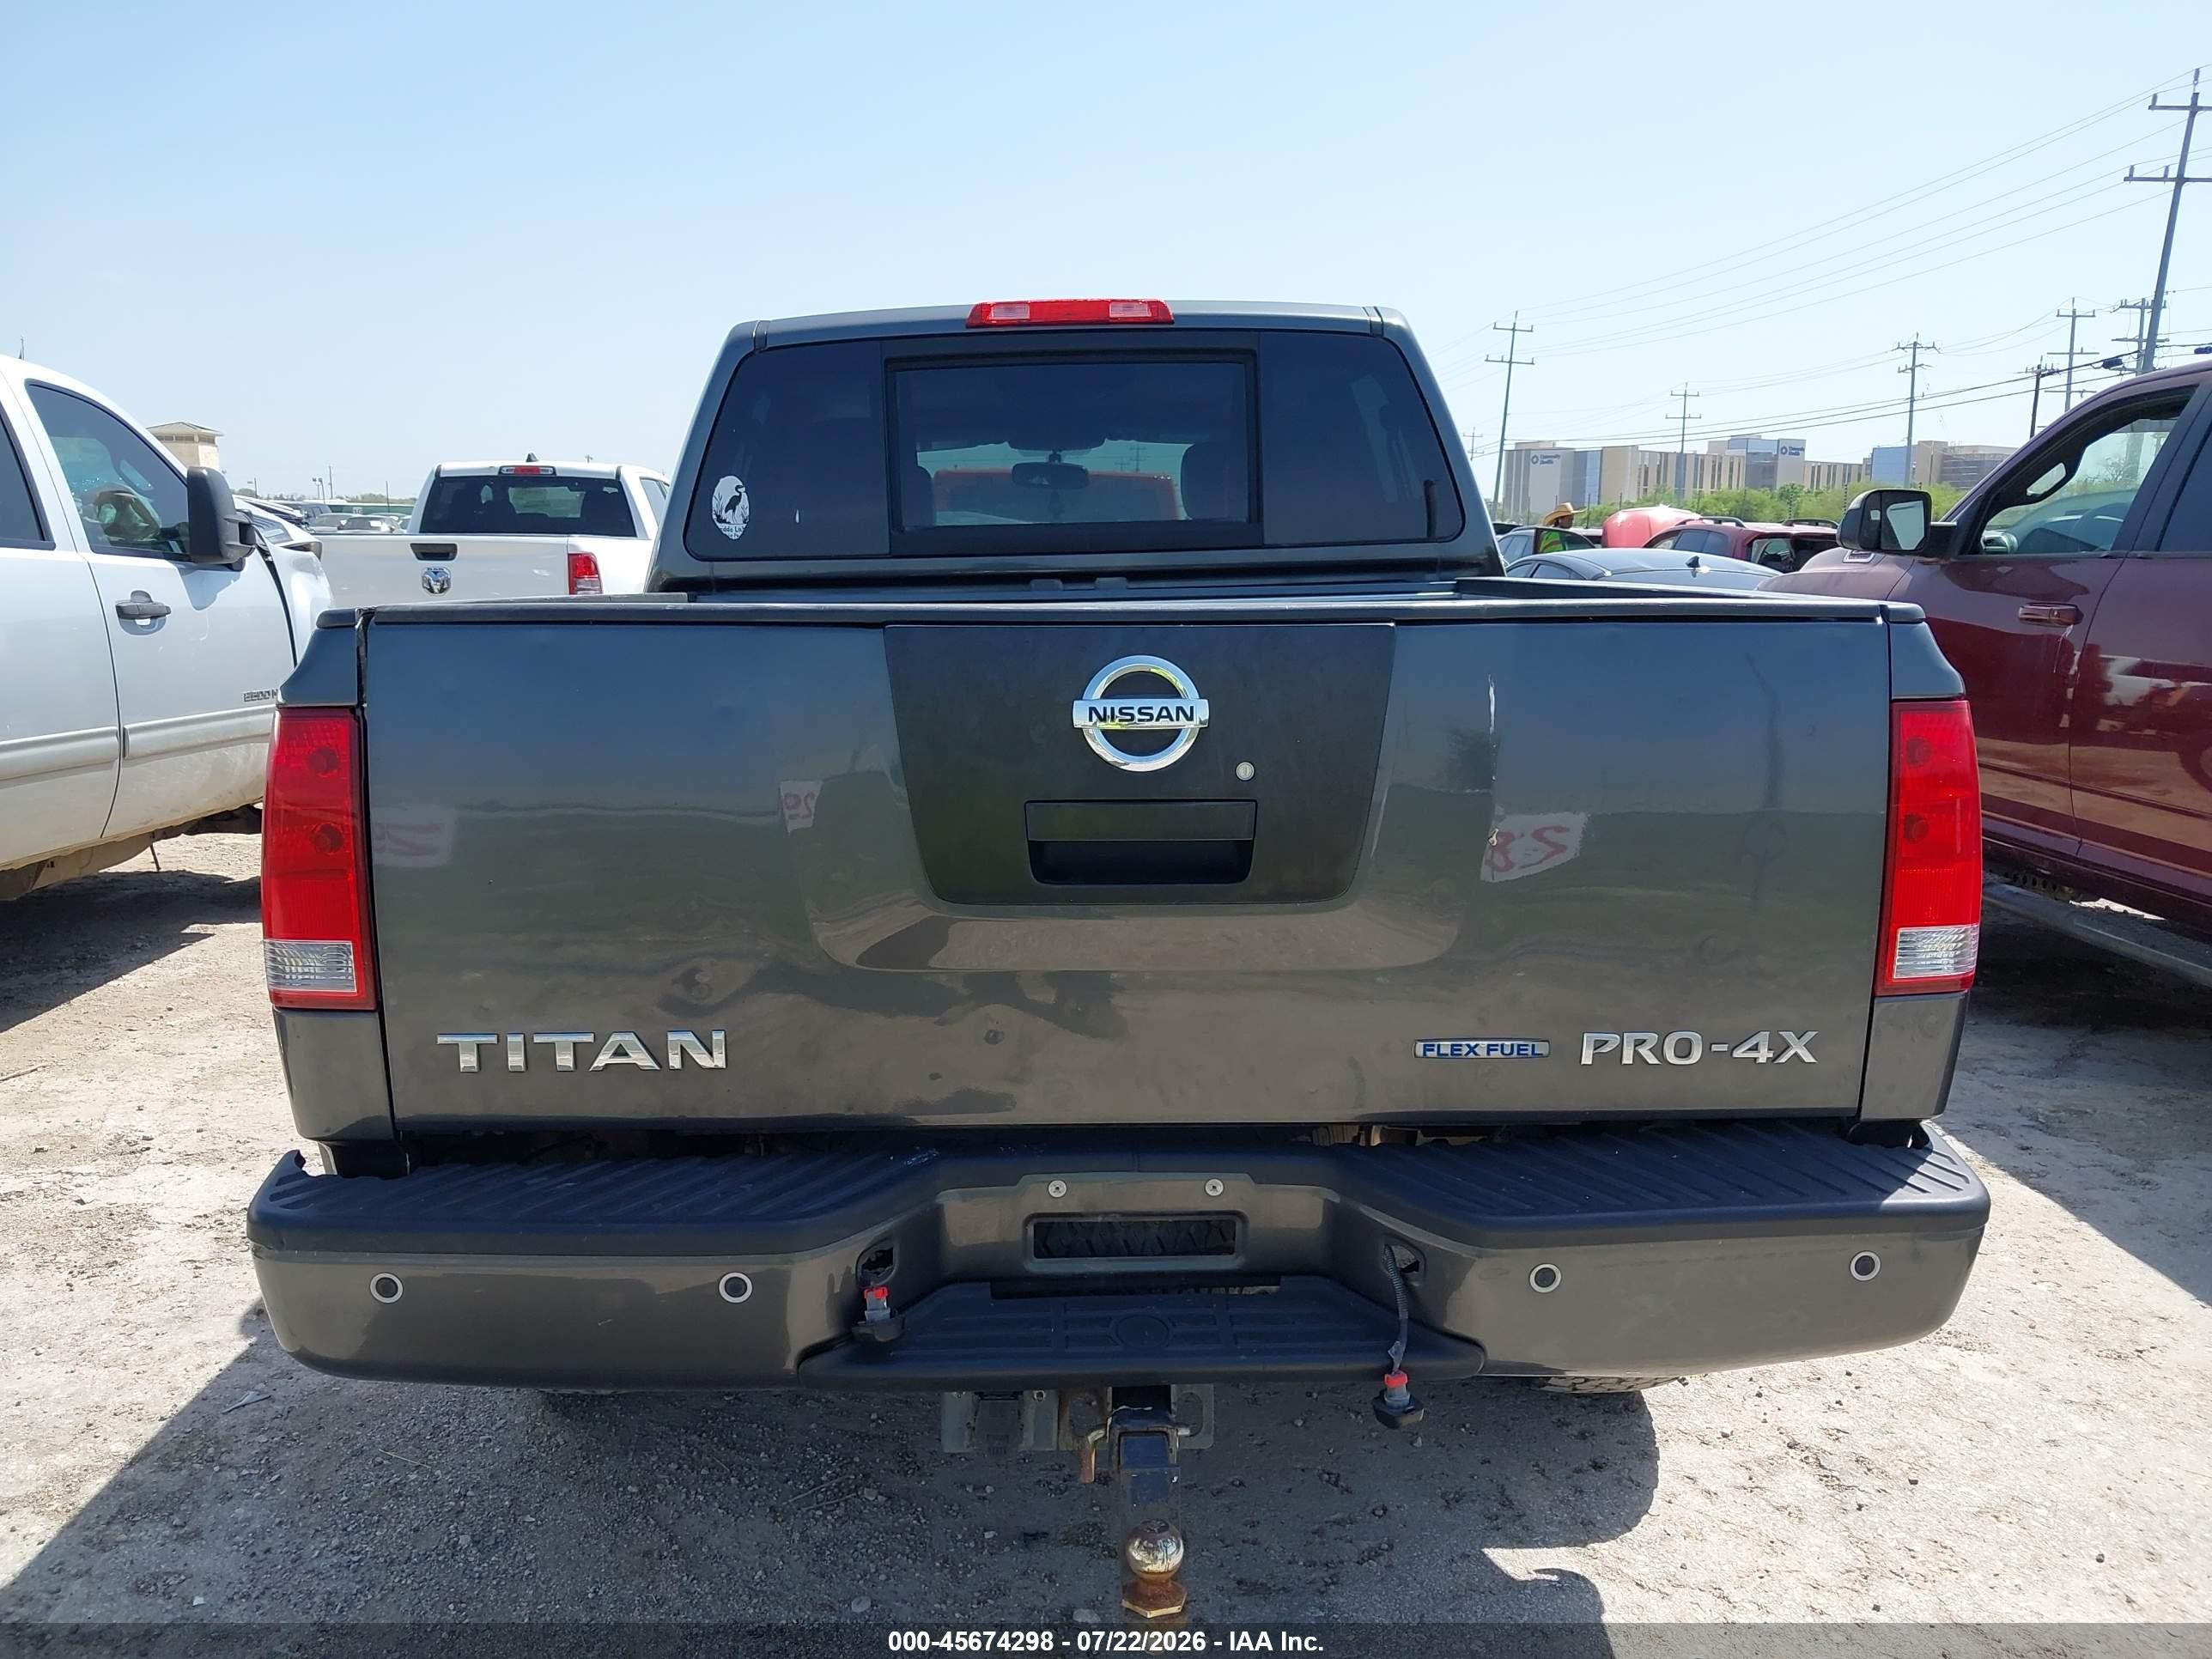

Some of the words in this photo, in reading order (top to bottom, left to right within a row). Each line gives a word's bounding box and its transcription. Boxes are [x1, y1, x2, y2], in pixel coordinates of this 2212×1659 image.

[1088, 705, 1194, 723] NISSAN
[436, 1030, 727, 1073] TITAN
[1422, 1042, 1481, 1057] FLEX
[1484, 1042, 1543, 1057] FUEL
[1580, 1030, 1819, 1066] PRO-4X
